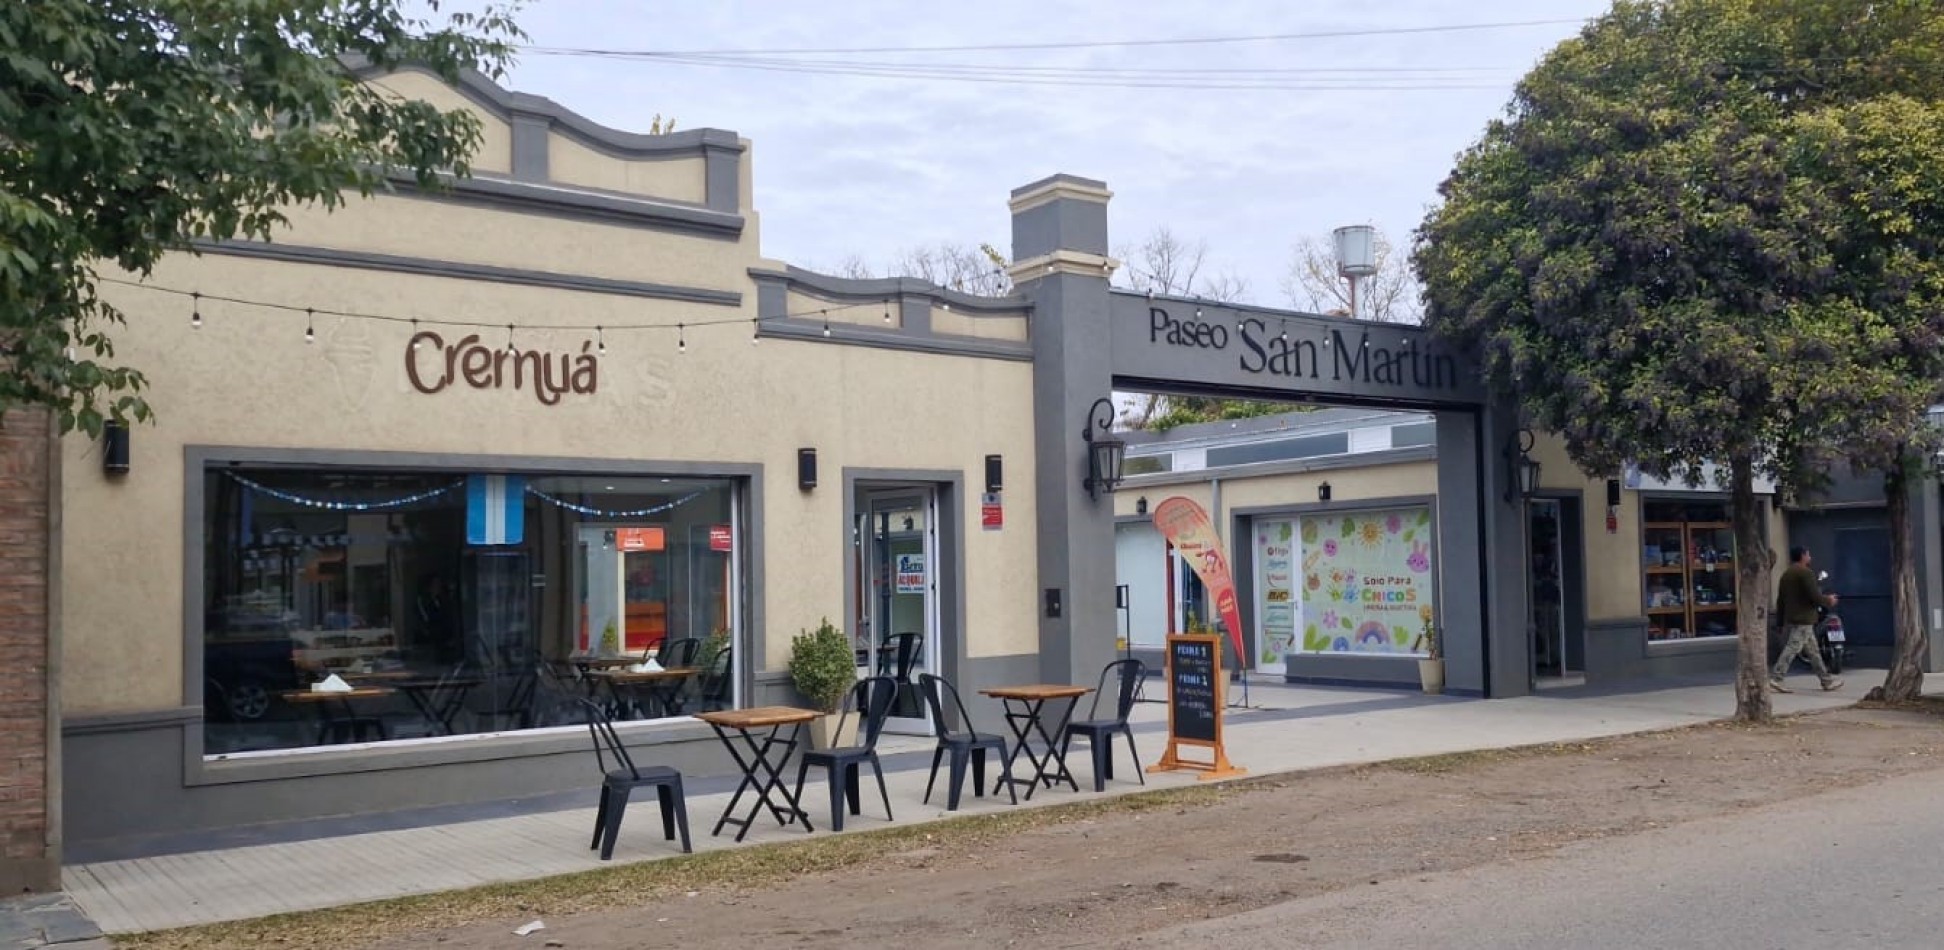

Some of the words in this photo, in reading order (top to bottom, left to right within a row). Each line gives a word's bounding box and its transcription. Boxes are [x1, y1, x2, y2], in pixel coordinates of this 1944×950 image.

[405, 331, 597, 406] Cremuá
[1149, 307, 1228, 349] Paseo
[1240, 317, 1317, 379] San
[1361, 588, 1417, 603] CHICOS
